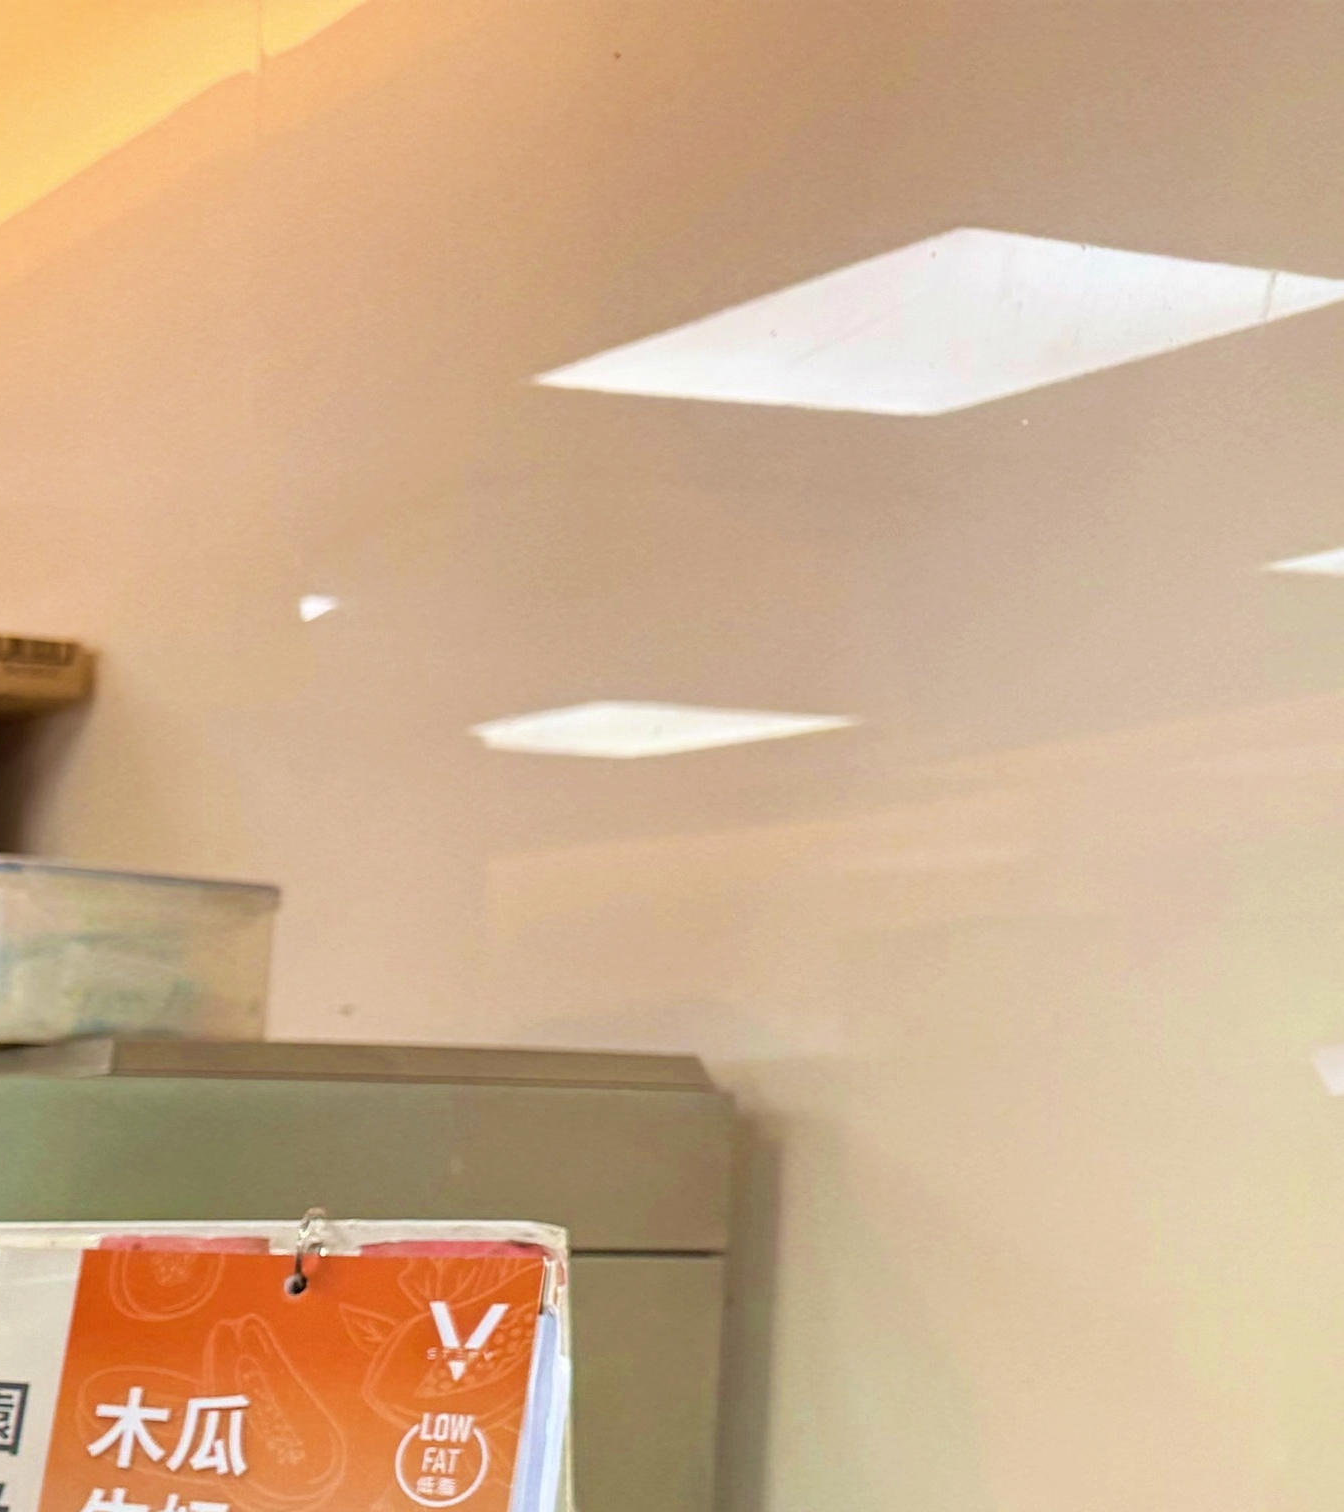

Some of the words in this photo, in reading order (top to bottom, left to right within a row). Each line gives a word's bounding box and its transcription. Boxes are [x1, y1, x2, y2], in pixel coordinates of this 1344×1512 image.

[87, 1386, 251, 1476] 木瓜
[419, 1413, 475, 1442] LOW
[421, 1447, 462, 1474] FAT
